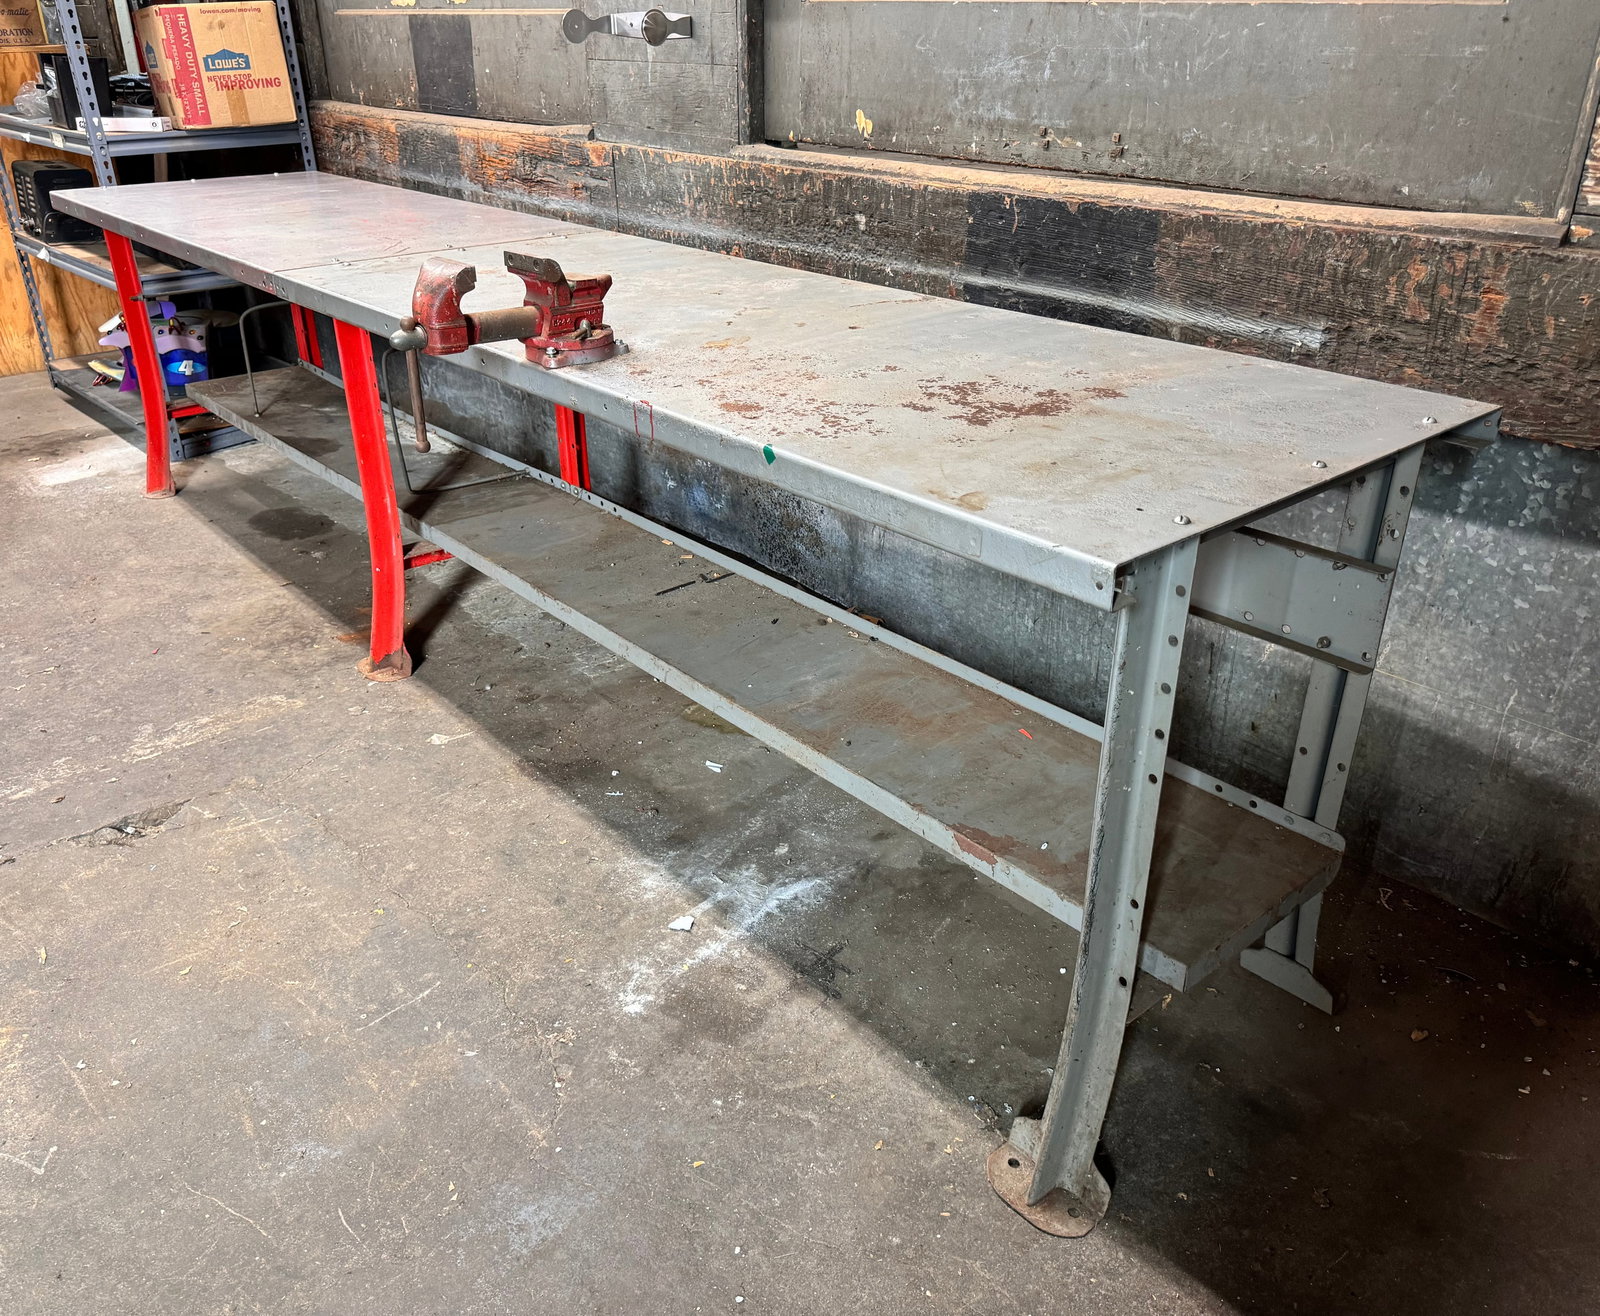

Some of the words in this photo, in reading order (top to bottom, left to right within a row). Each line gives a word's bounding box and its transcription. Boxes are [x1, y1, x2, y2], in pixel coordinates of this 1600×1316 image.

[176, 13, 191, 48] HEAVY
[185, 51, 198, 79] DUTY
[192, 81, 205, 116] SMALL
[215, 77, 282, 91] IMPROVING
[178, 360, 194, 376] 4
